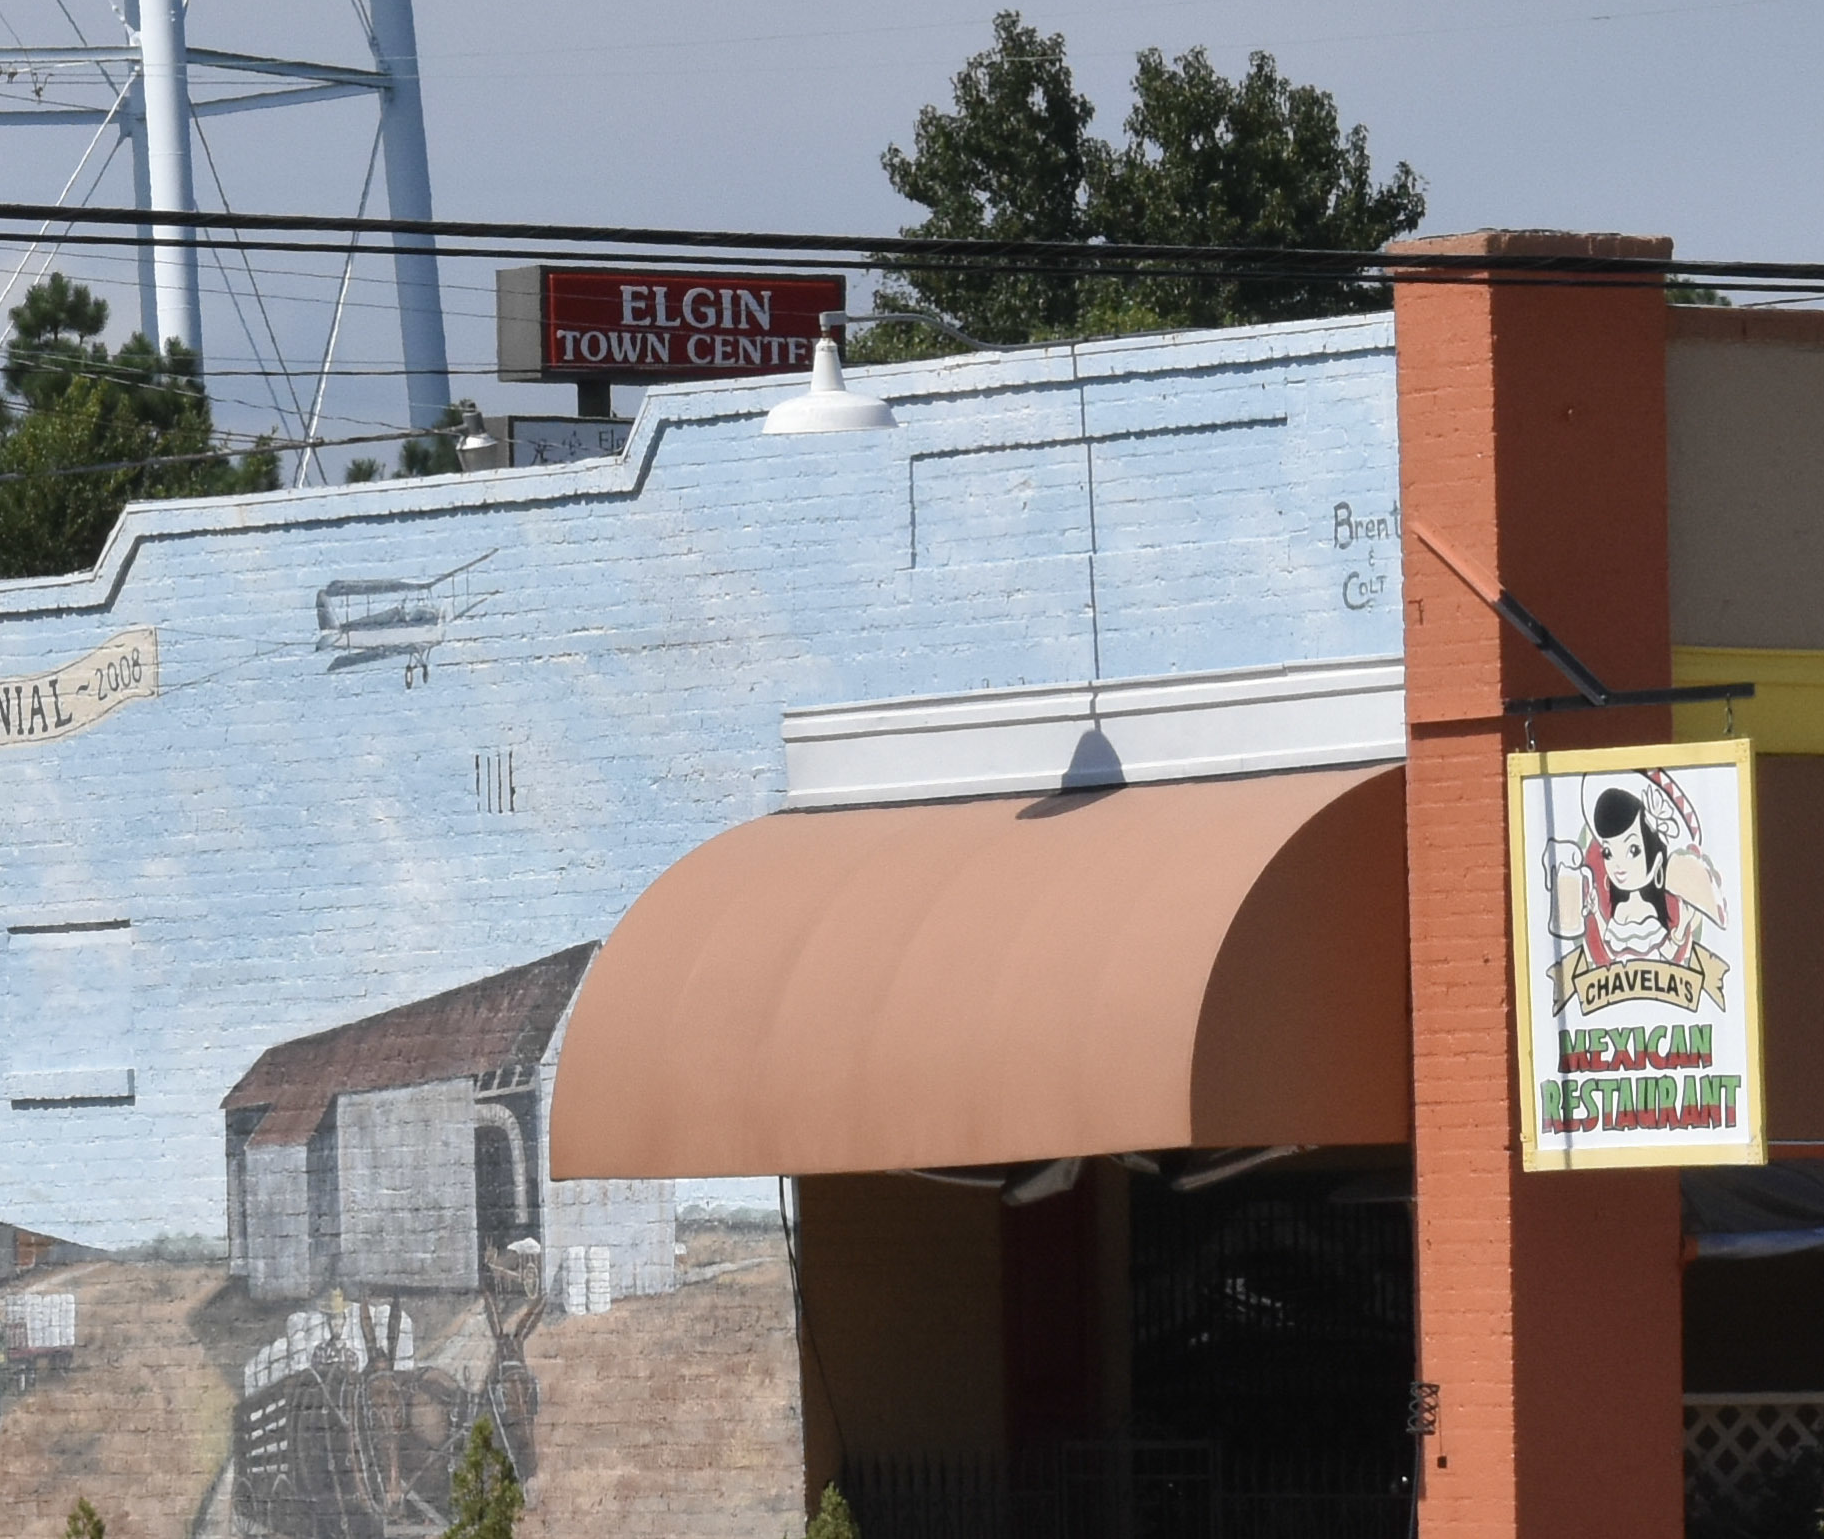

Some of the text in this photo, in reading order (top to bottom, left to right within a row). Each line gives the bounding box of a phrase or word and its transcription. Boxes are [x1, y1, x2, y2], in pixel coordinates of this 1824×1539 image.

[619, 285, 772, 331] ELGIN
[556, 329, 670, 363] TOWN
[1584, 969, 1695, 1007] CHAVELA'S
[1557, 1023, 1714, 1074] MEXICAN
[1540, 1074, 1742, 1134] RESTAURANT
